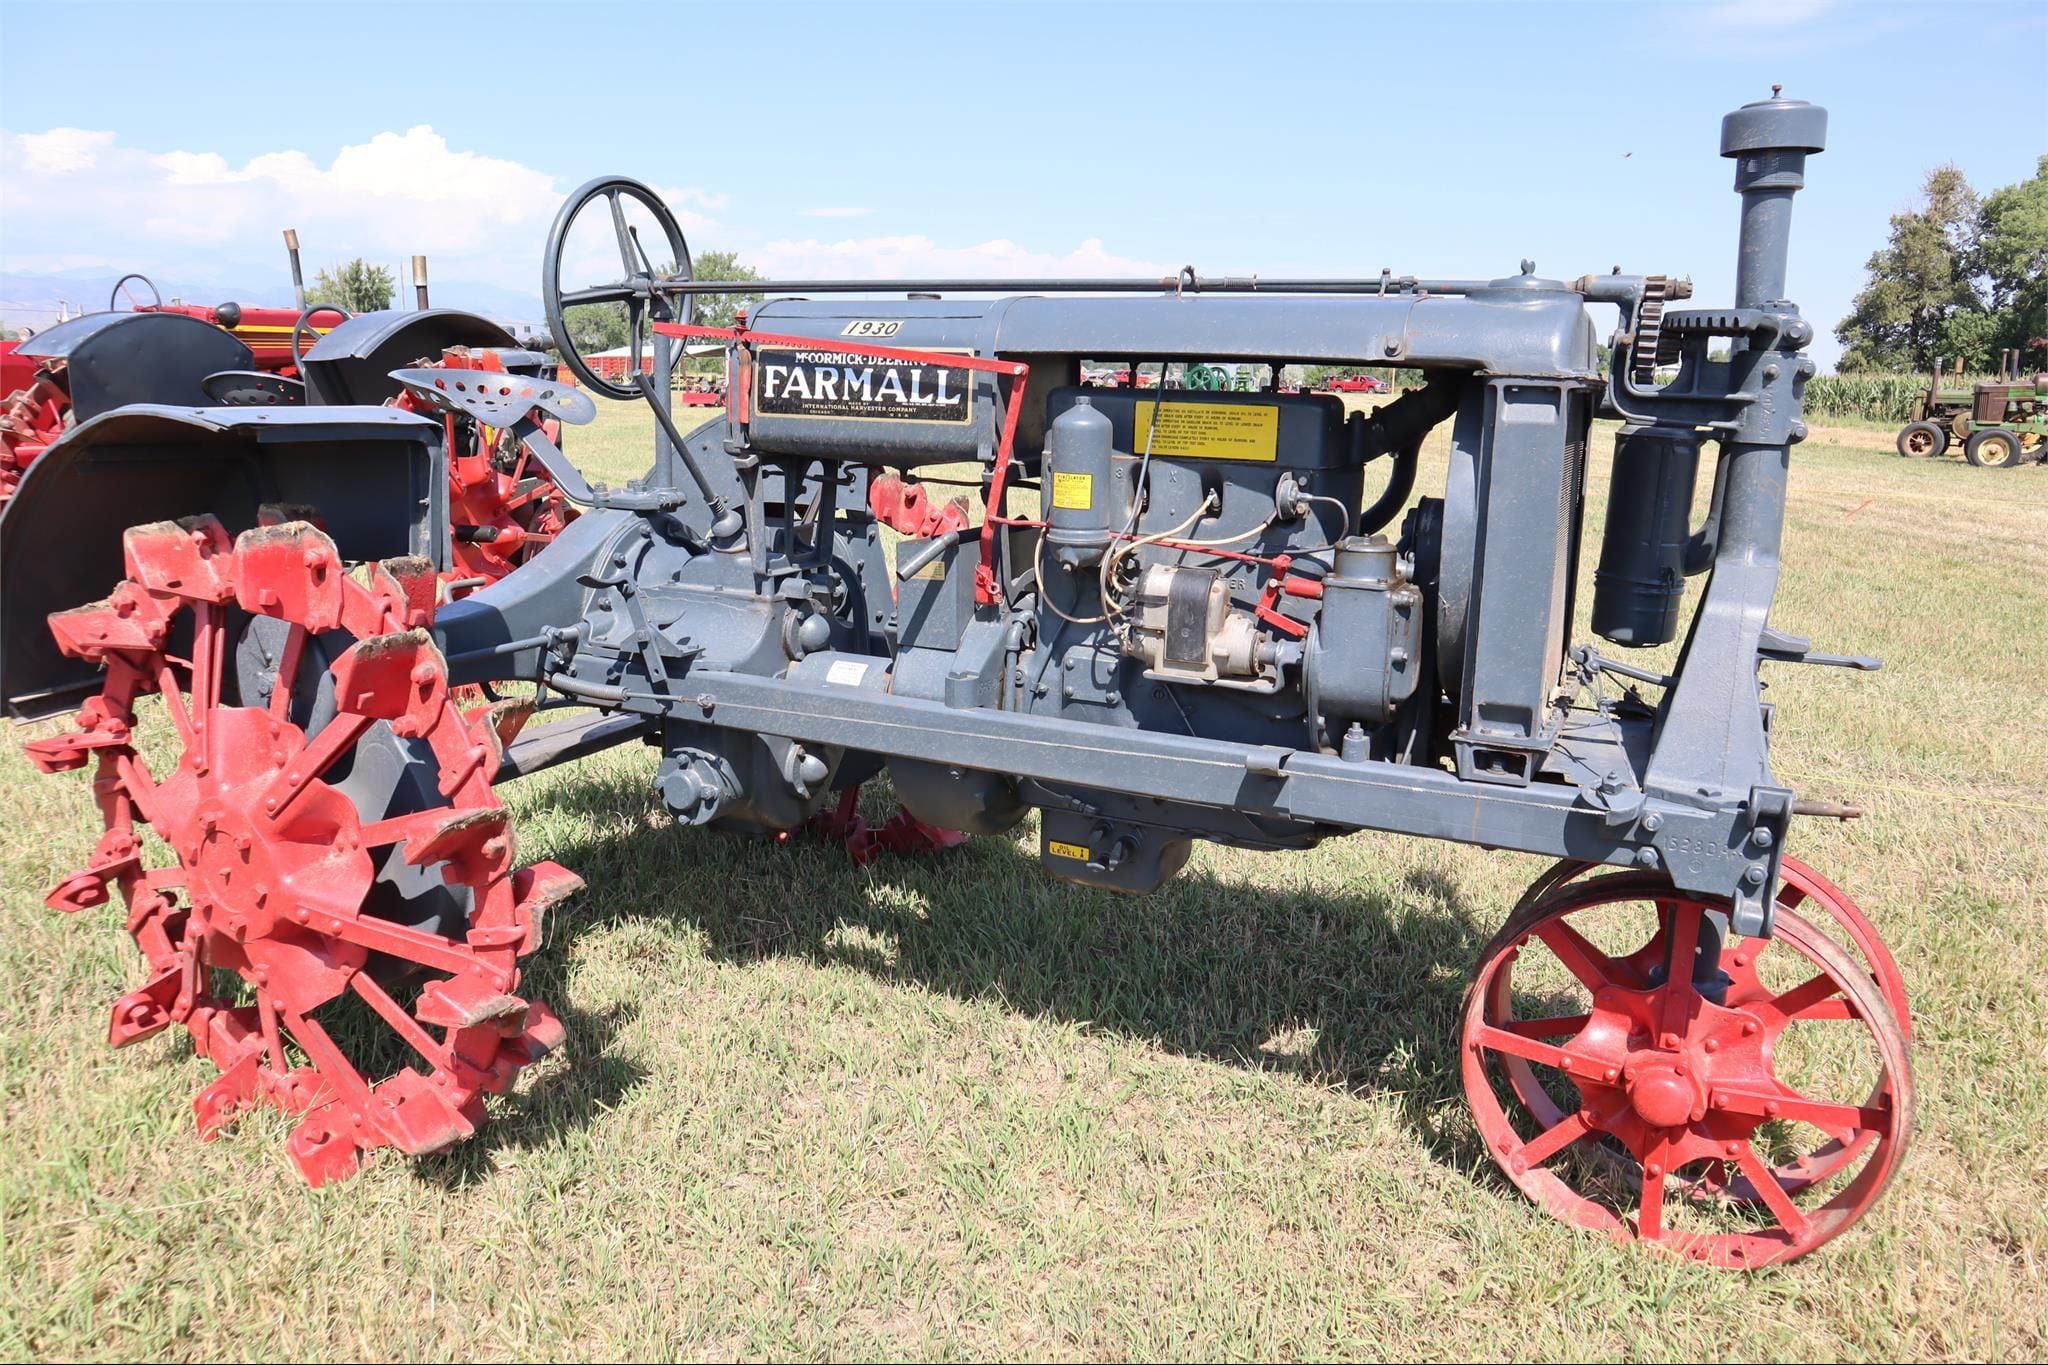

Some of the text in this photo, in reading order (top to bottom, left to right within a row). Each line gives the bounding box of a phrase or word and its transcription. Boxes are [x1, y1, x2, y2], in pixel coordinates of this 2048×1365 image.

[847, 321, 899, 335] 1930
[764, 365, 962, 405] FARMALL
[1052, 848, 1076, 857] LEVEL
